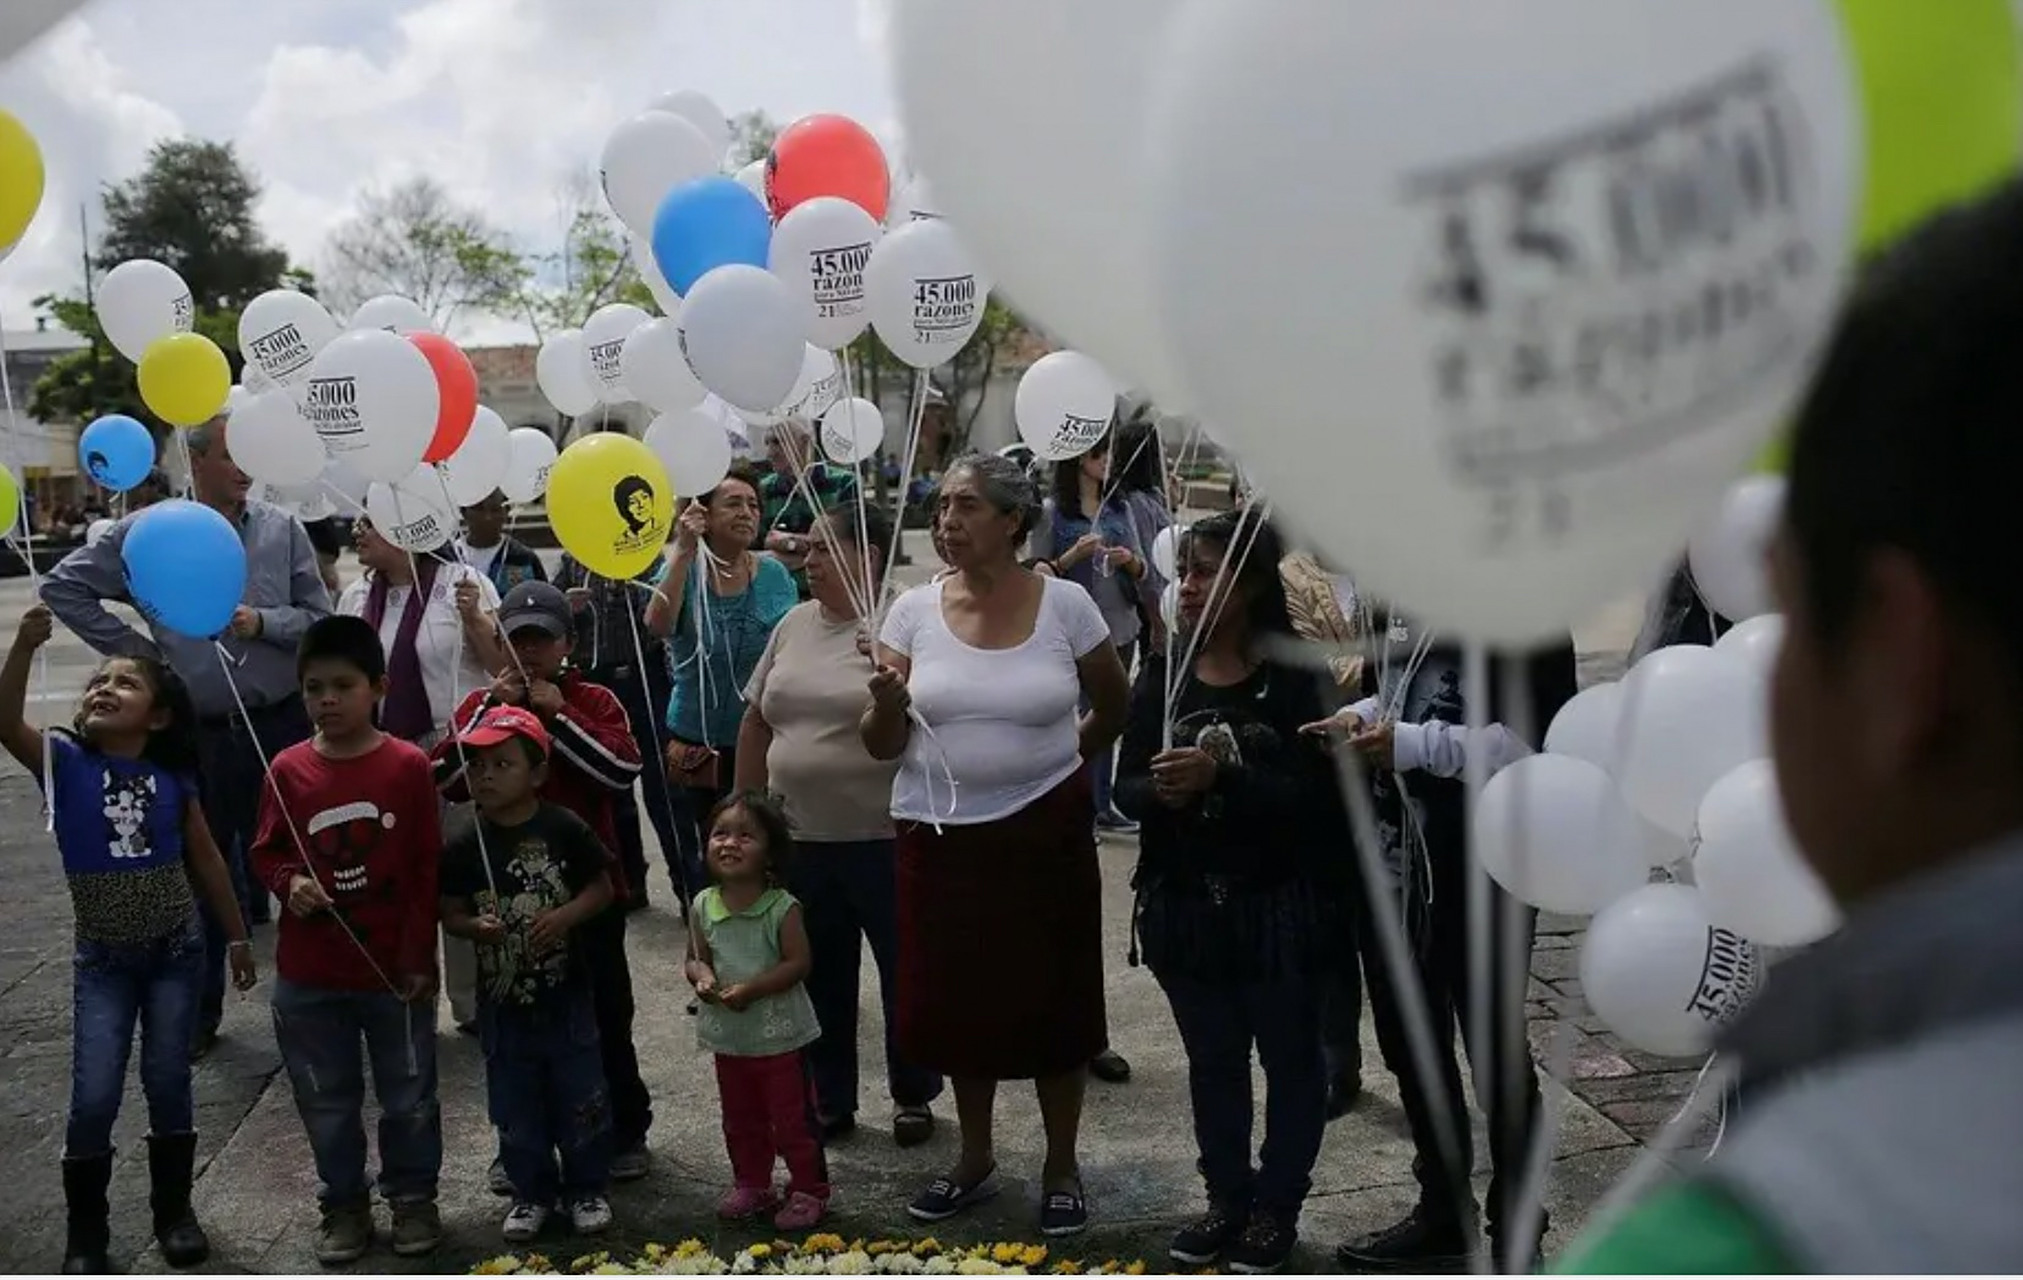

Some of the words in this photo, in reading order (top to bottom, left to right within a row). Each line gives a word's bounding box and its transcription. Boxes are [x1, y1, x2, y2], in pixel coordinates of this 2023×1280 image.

[813, 273, 863, 291] razon
[914, 279, 975, 304] 45.000
[818, 305, 835, 318] 21
[1696, 928, 1738, 1021] 45.000
